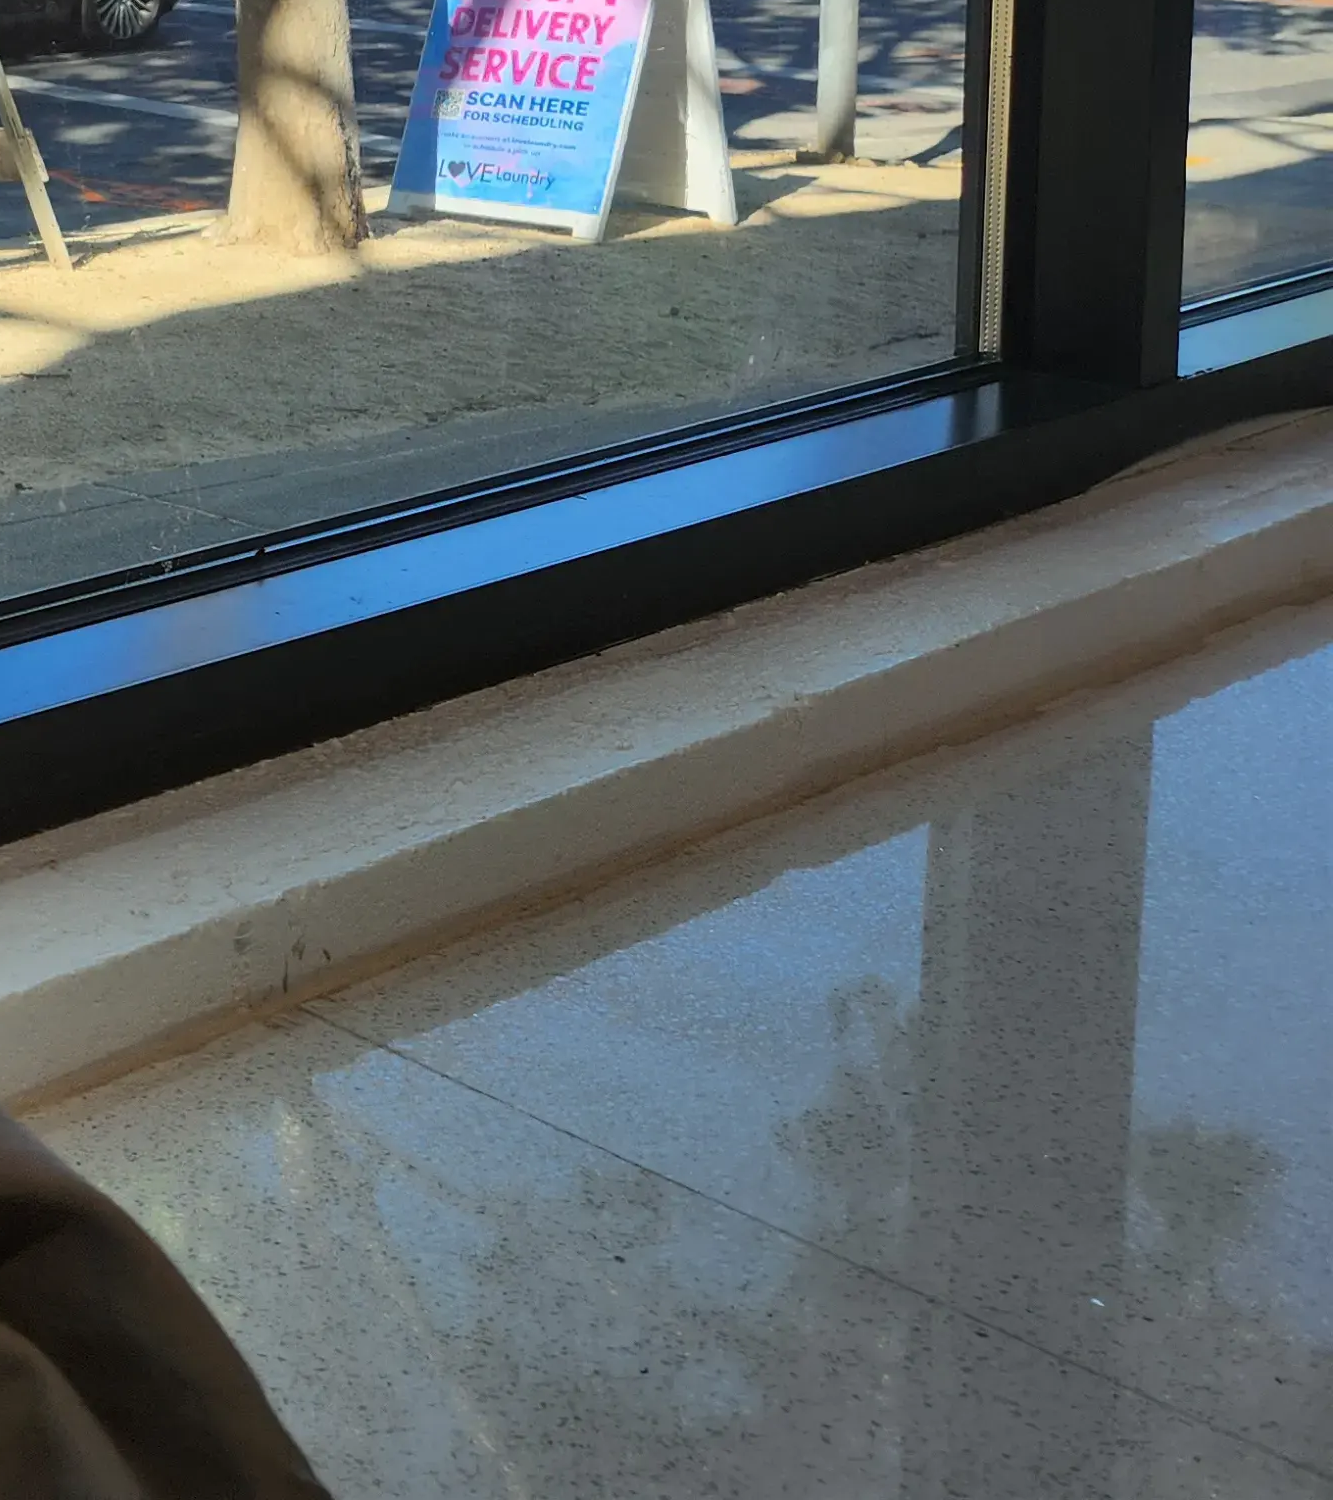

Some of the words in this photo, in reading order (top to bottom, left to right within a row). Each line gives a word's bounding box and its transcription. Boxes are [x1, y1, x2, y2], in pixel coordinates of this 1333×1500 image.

[449, 6, 616, 45] DELIVERY
[438, 46, 602, 92] SERVICE
[465, 91, 524, 111] SCAN
[529, 96, 590, 116] HERE
[463, 110, 490, 123] FOR
[493, 113, 585, 132] SCHEDULING
